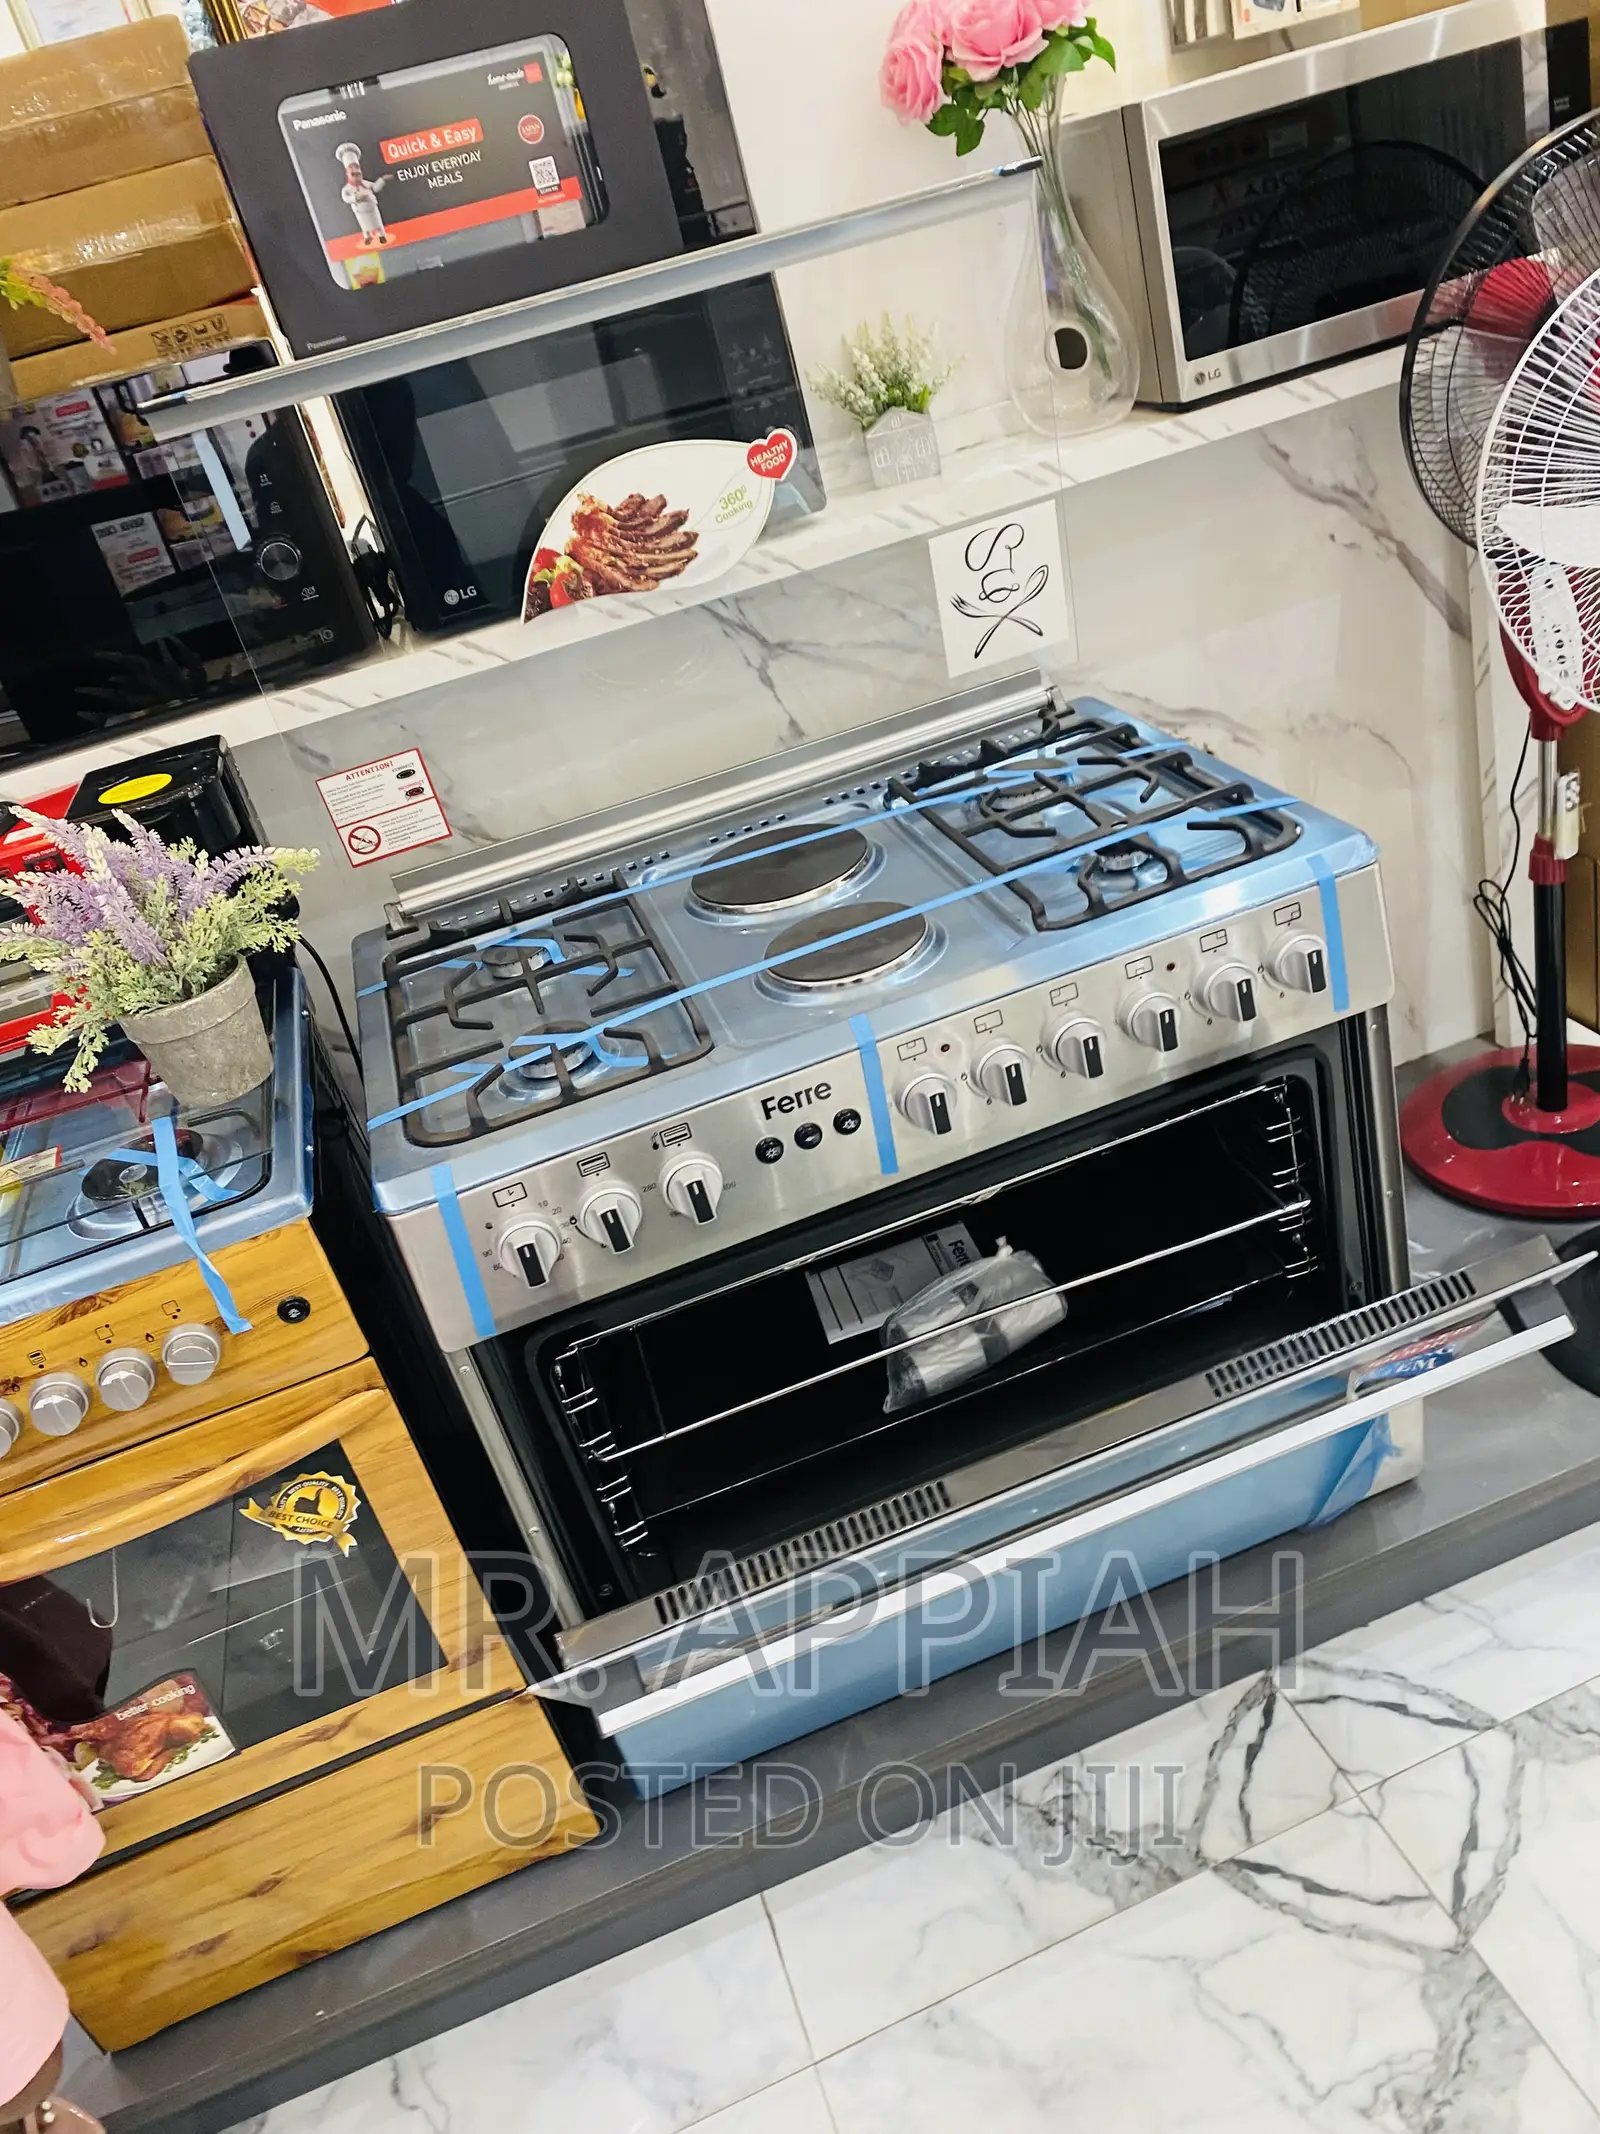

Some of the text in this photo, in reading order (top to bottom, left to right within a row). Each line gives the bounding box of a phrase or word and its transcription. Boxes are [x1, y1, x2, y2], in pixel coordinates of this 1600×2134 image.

[292, 109, 347, 131] Panasonic
[387, 126, 477, 159] Quick & Easy
[396, 150, 482, 182] ENJOY EVERYDAY
[427, 171, 464, 189] MEALS
[1207, 367, 1222, 381] LG
[749, 440, 789, 468] HEALTHY
[760, 452, 787, 472] FOOD
[715, 499, 754, 524] Cooking
[459, 585, 478, 600] LG
[345, 760, 394, 782] ATTENTION!
[22, 852, 40, 861] Coffee
[760, 1082, 832, 1121] Ferre
[268, 1510, 335, 1529] BEST CHOICE
[115, 1684, 196, 1721] better cooking
